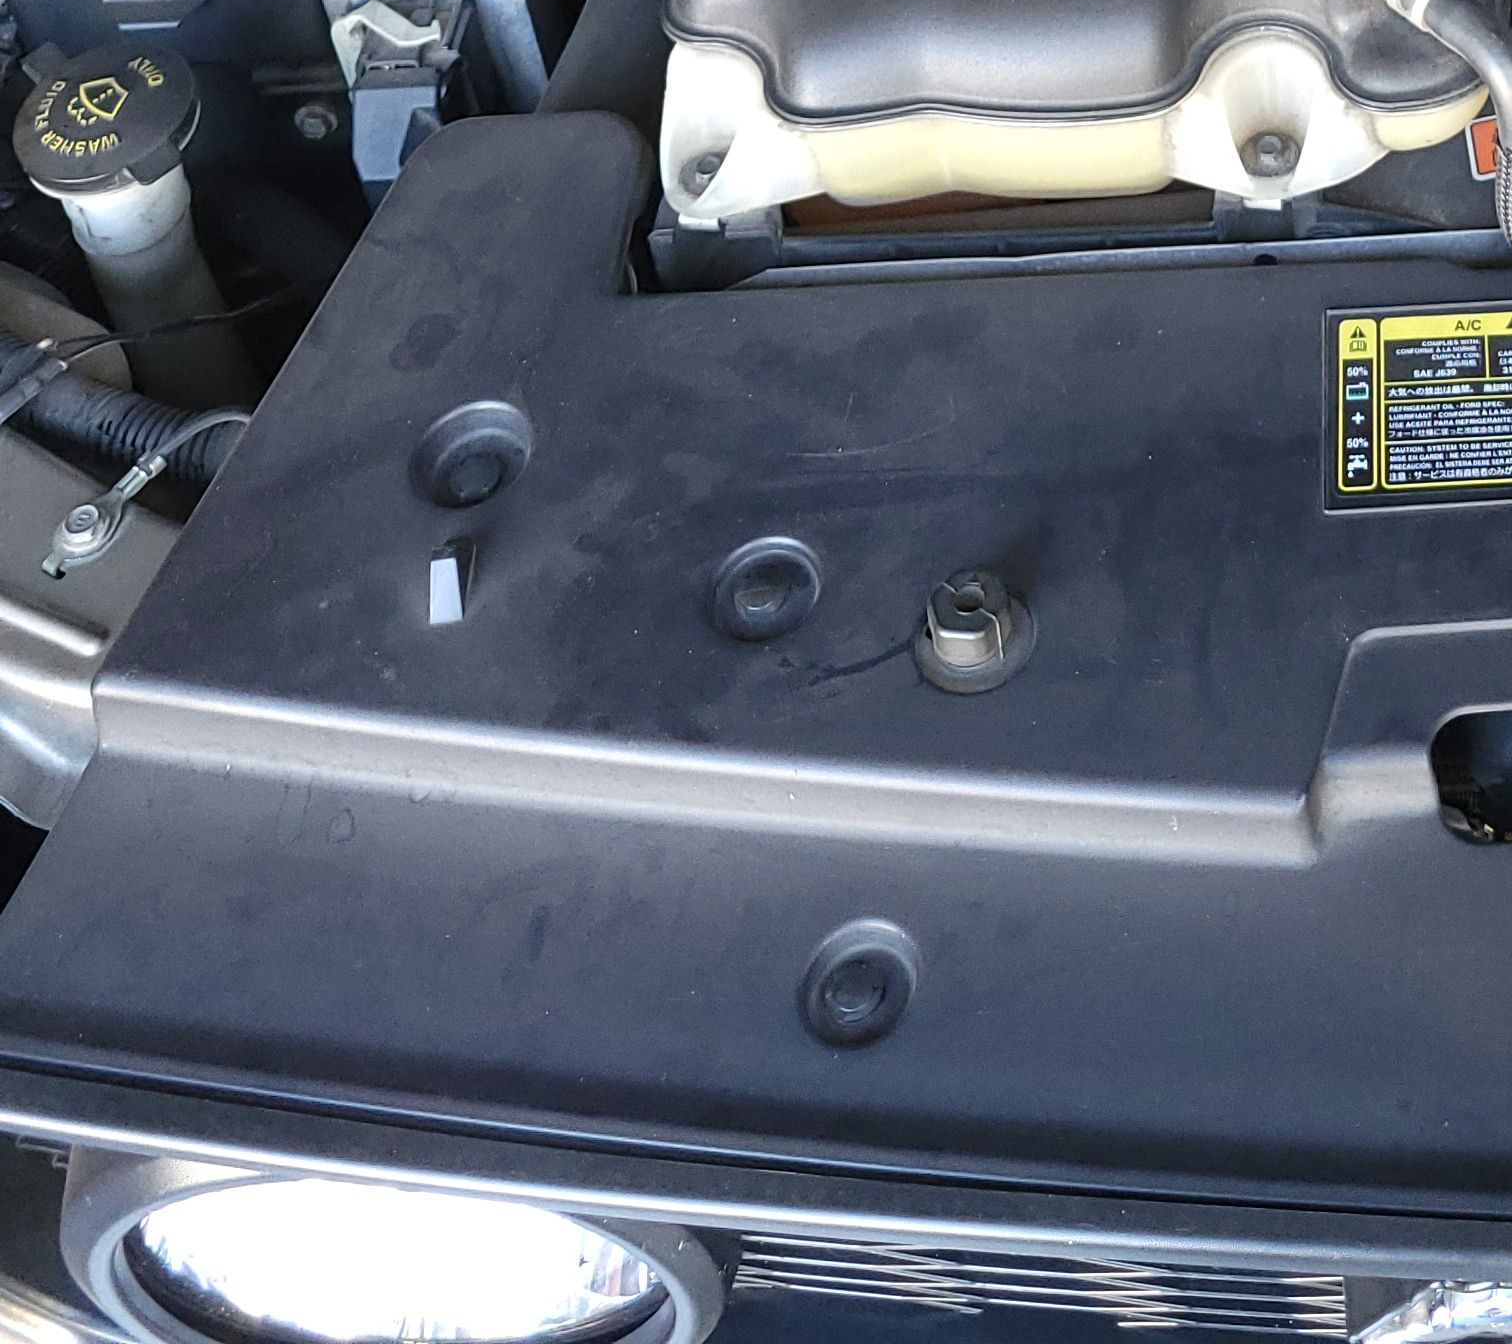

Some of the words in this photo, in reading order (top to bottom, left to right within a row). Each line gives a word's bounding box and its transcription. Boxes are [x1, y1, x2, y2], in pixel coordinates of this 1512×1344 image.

[128, 56, 165, 87] ONLY
[34, 80, 67, 131] FLUID
[40, 130, 121, 157] WASHER
[1455, 319, 1482, 332] A/C
[1347, 367, 1368, 377] 50%
[1414, 370, 1433, 378] SAE
[1435, 369, 1456, 378] J639
[1389, 403, 1440, 412] REFRIGERANT
[1438, 410, 1480, 418] CONFORME
[1405, 420, 1432, 428] ACEITE
[1433, 418, 1454, 426] PARA
[1347, 438, 1368, 448] 50%
[1389, 445, 1424, 454] CAUTION:
[1427, 443, 1457, 452] SYSTEM
[1471, 442, 1480, 450] BE
[1389, 454, 1406, 462] MISE
[1408, 453, 1419, 461] EN
[1450, 451, 1459, 459] NE
[1460, 450, 1492, 458] CONFIER
[1491, 457, 1504, 465] SER
